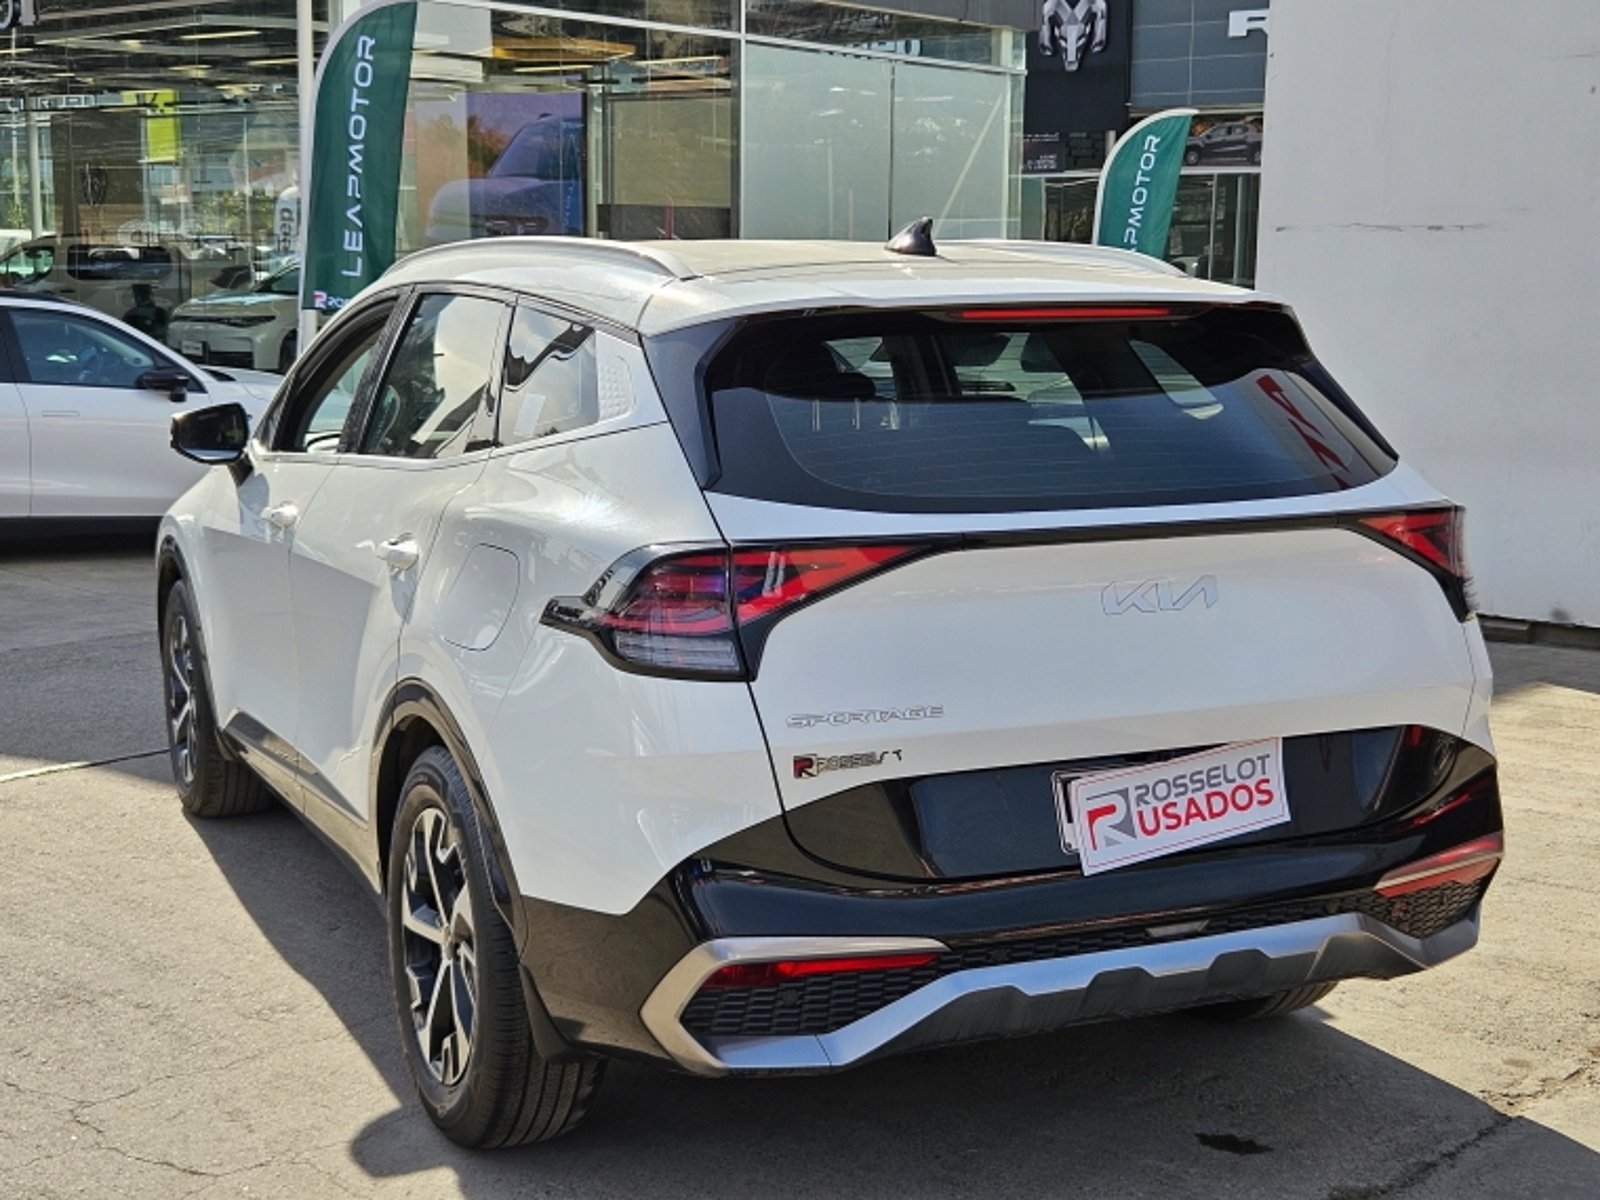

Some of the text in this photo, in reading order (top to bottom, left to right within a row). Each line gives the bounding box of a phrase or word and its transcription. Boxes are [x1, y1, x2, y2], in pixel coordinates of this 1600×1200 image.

[341, 35, 376, 277] LEAPMOTOR
[1123, 134, 1161, 252] PMOTOR
[1101, 574, 1218, 615] KIA
[785, 704, 945, 729] SPORTAGE
[1134, 754, 1270, 807] ROSSELOT
[1138, 778, 1275, 837] USADOS
